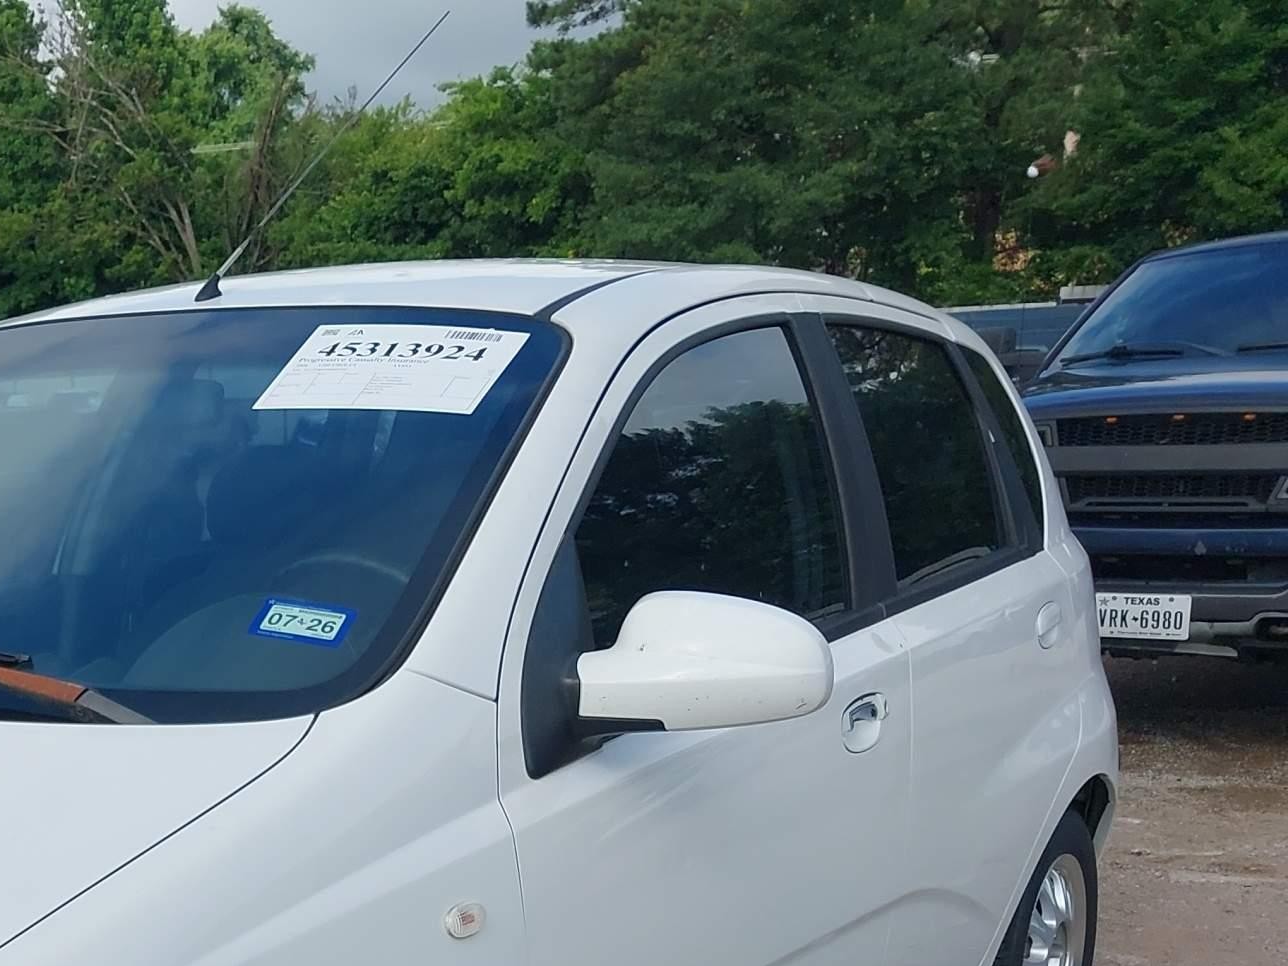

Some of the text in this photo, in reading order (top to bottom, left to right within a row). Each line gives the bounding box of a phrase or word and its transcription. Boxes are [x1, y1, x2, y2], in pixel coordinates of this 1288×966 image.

[318, 341, 488, 362] 45313924
[1123, 597, 1160, 606] TEXAS
[1099, 608, 1183, 630] VRK 6980
